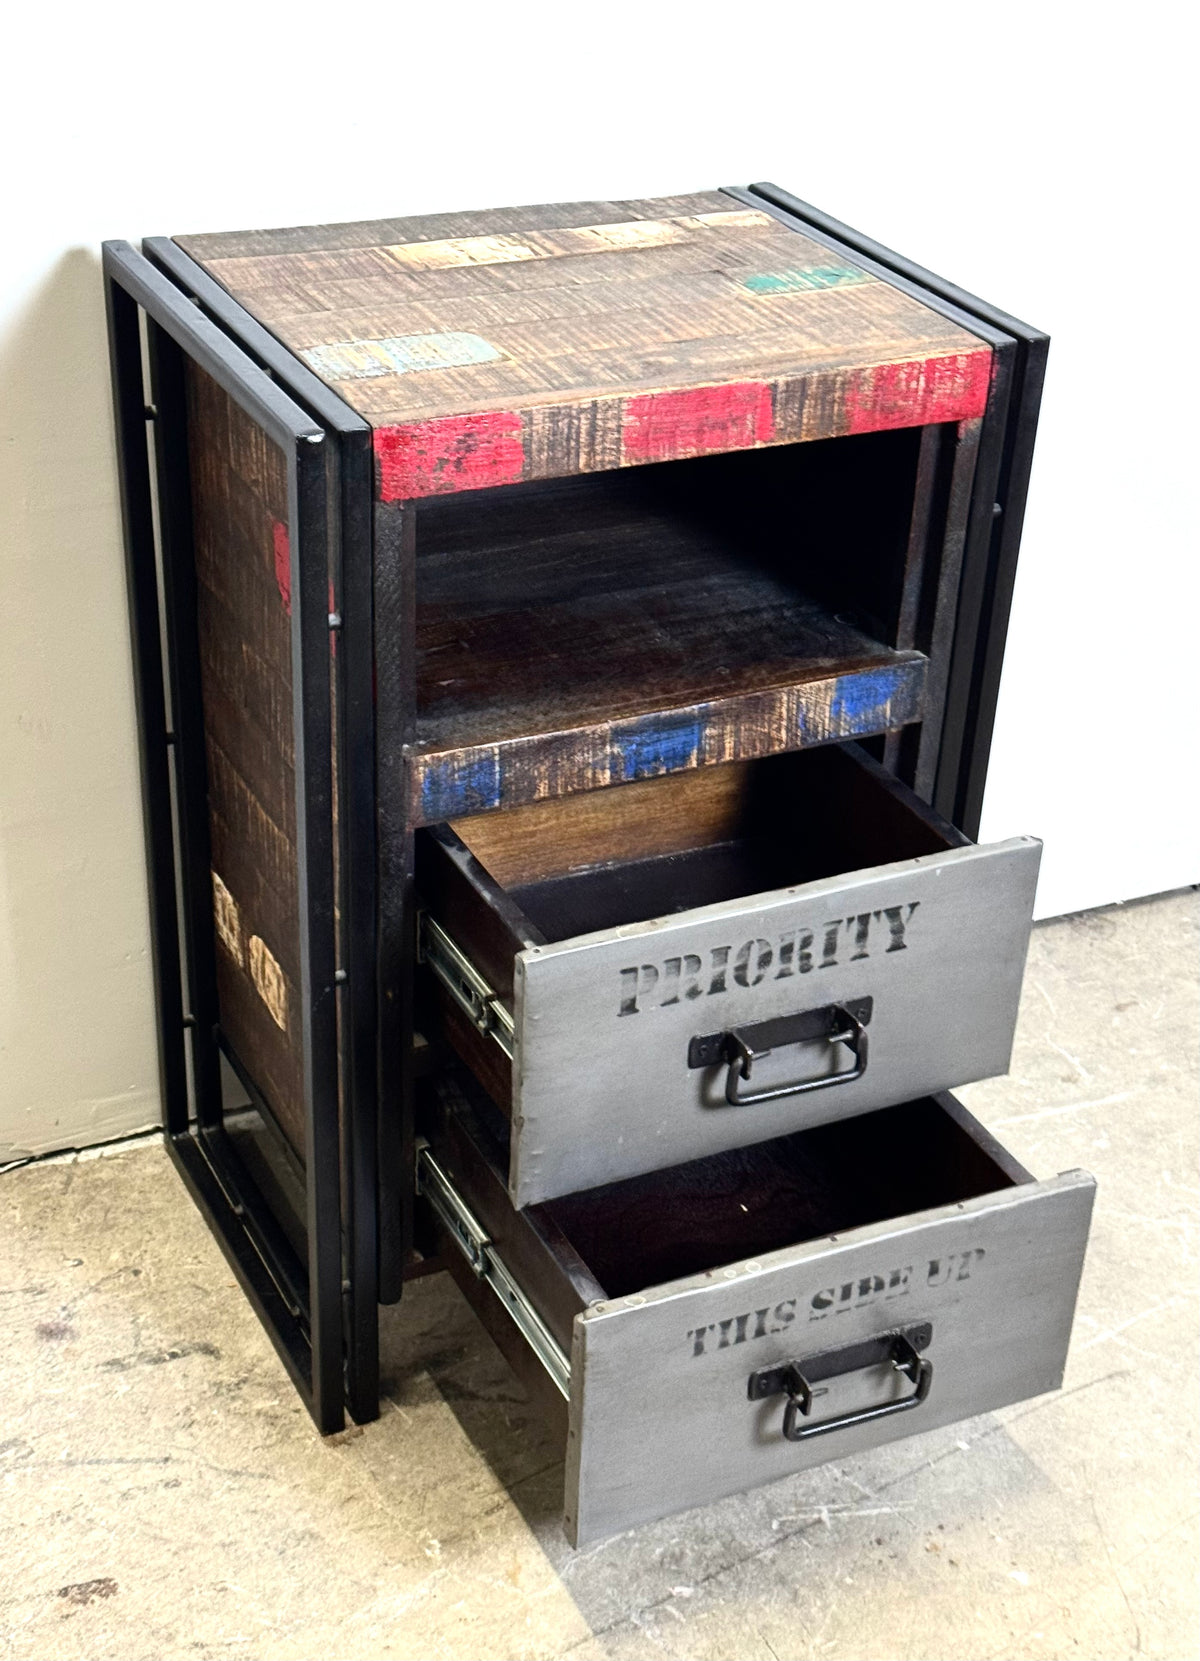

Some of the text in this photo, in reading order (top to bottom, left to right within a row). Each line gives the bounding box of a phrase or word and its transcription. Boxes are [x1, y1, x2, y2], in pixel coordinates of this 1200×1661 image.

[616, 901, 921, 1017] PRIORITY
[686, 1247, 987, 1358] THIS SIDE UP
